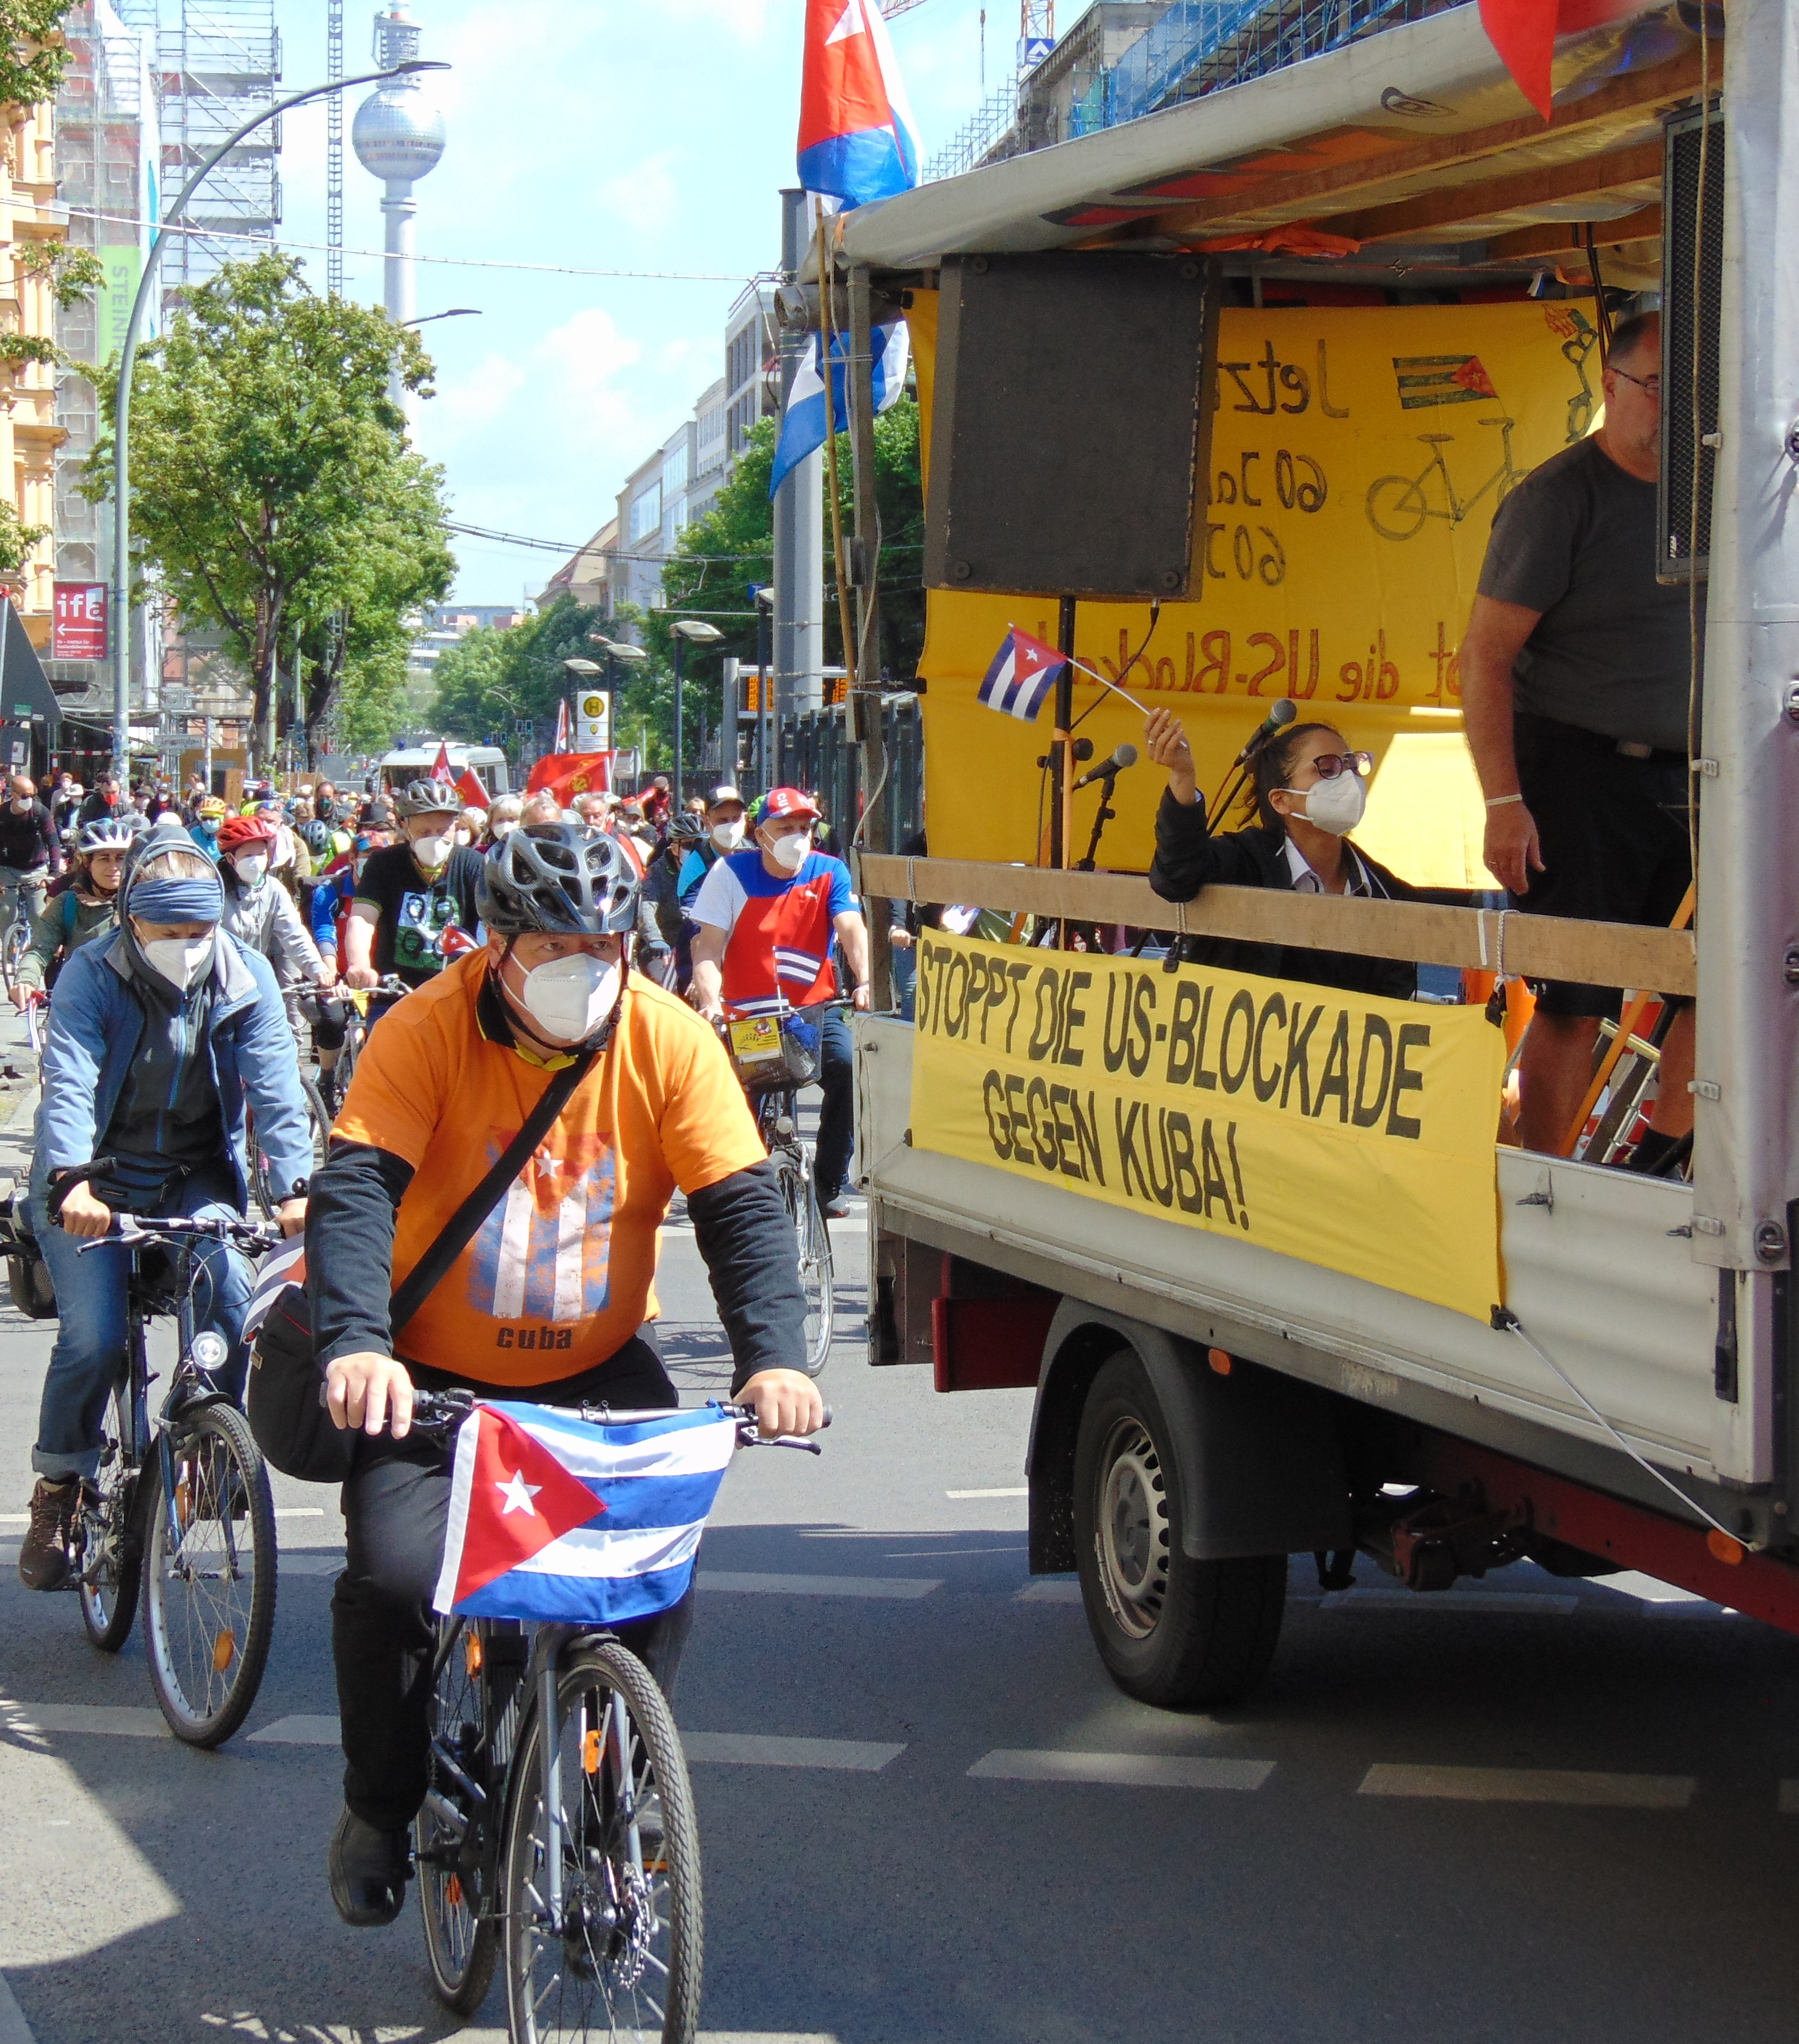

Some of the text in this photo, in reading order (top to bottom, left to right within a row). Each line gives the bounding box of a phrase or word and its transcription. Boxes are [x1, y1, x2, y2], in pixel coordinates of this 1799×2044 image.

[57, 594, 103, 617] ifa
[589, 701, 599, 713] H
[919, 939, 1430, 1139] STOPPT DIE US-BLOCKADE
[983, 1069, 1250, 1231] GEGEN KUBA!
[496, 1326, 572, 1349] cuba
